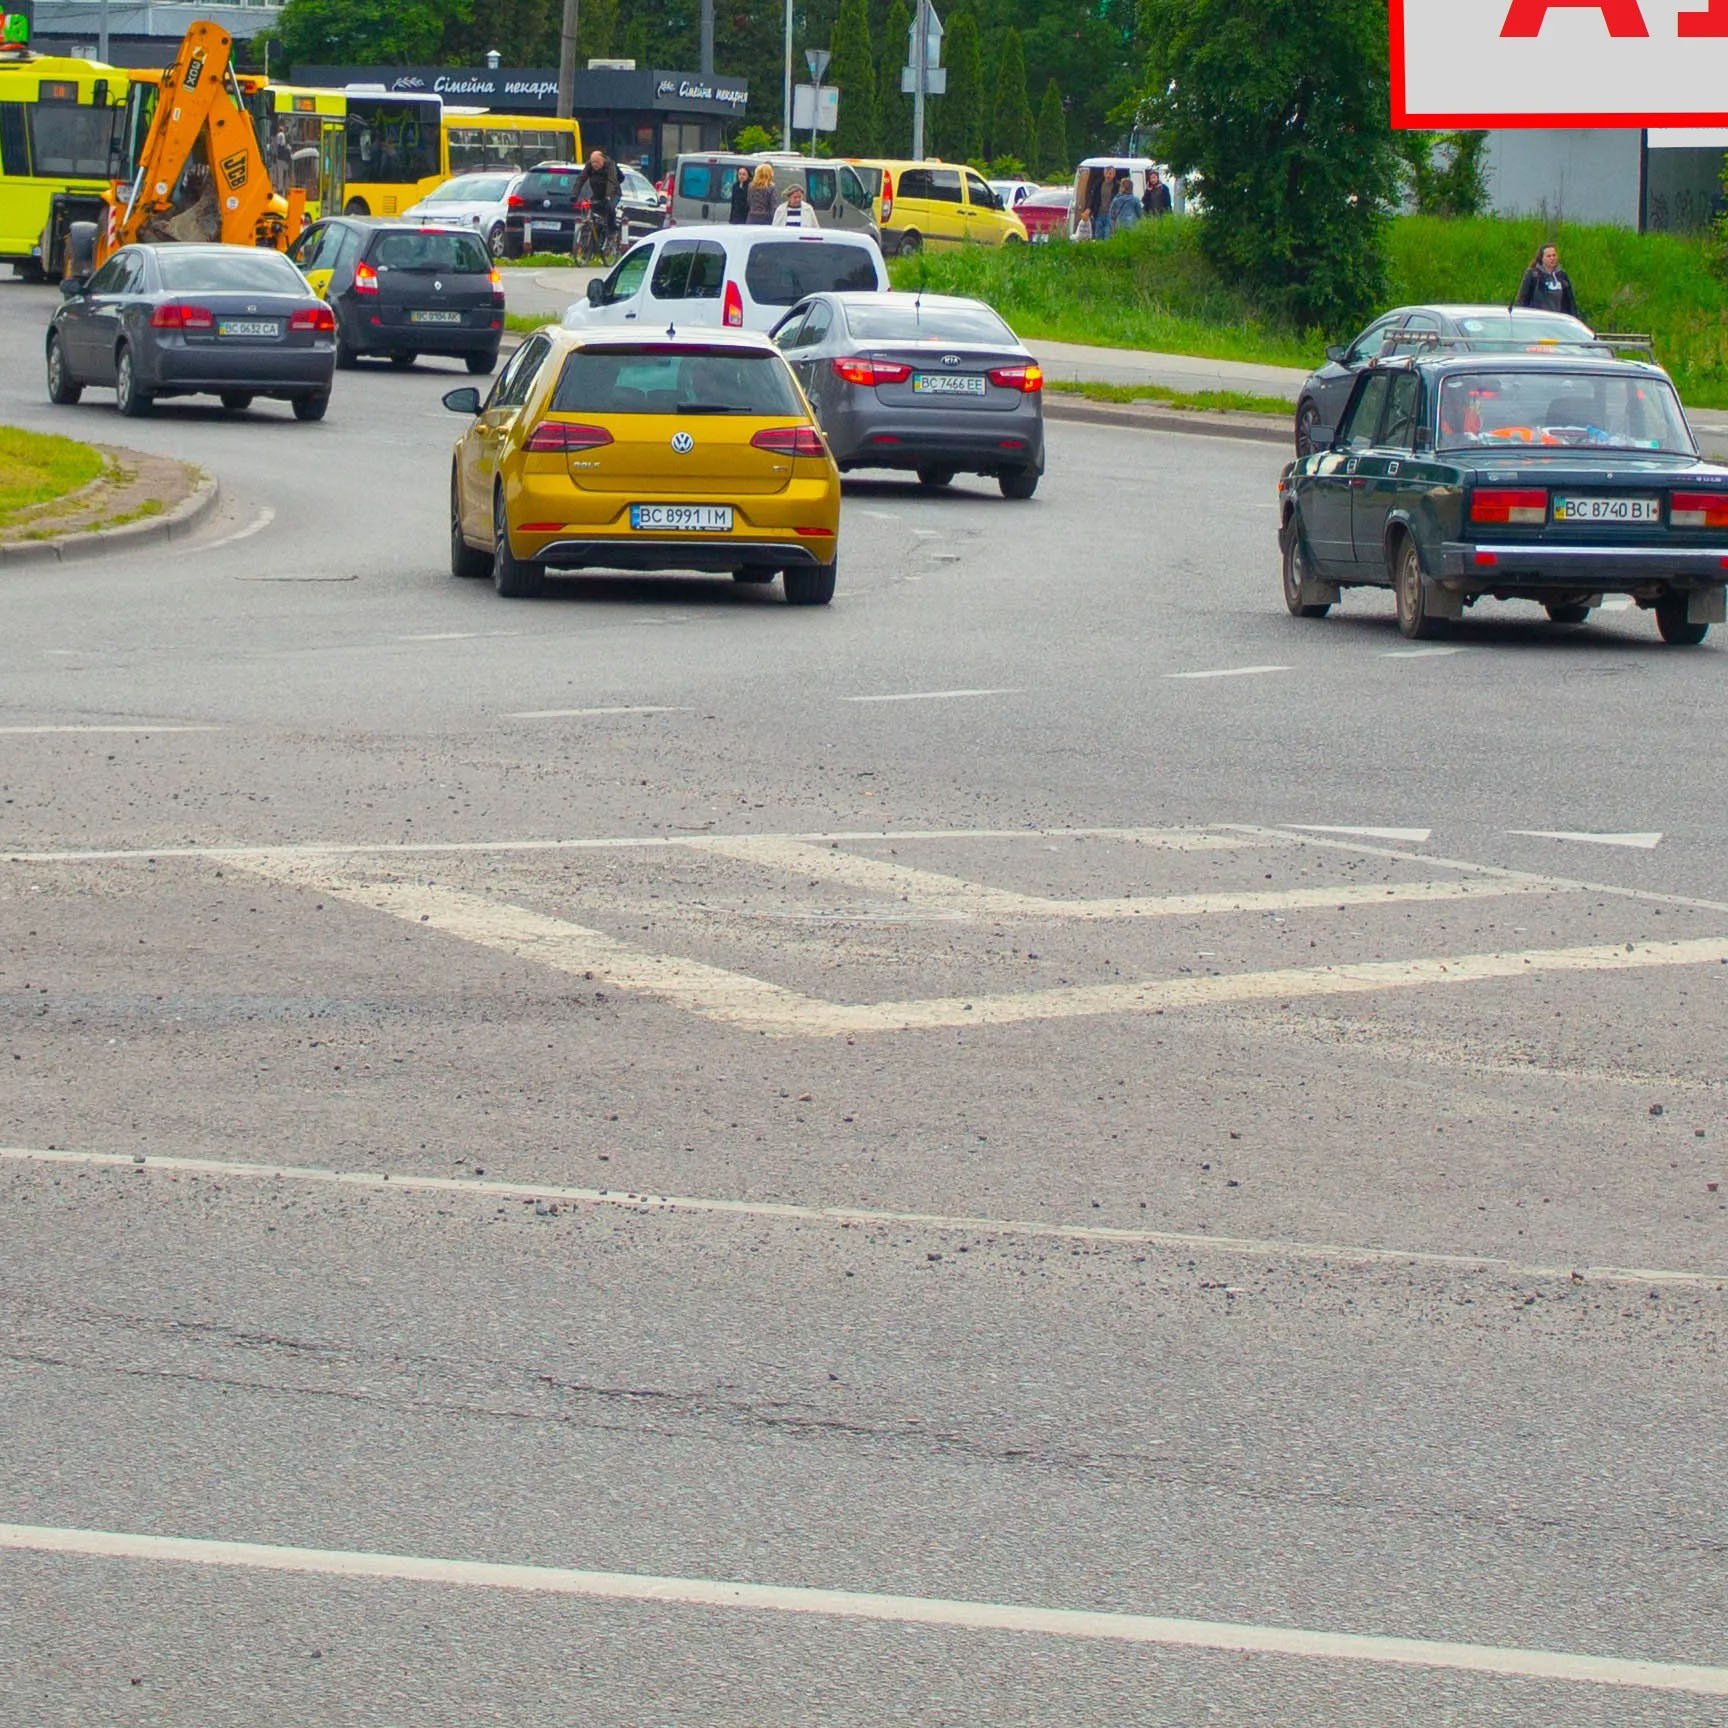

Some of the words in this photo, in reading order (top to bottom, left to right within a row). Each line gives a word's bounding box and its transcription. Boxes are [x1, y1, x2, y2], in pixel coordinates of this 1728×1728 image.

[434, 76, 495, 93] Сімейна
[504, 80, 560, 101] пекарн
[223, 155, 247, 187] JCB
[921, 377, 938, 389] BC
[940, 378, 965, 390] 7466
[967, 378, 983, 391] EE
[640, 508, 664, 523] BC
[666, 508, 701, 523] 8991
[706, 510, 726, 525] IM
[1565, 502, 1588, 516] BC
[1592, 502, 1628, 518] 8740
[1631, 503, 1650, 519] BI
